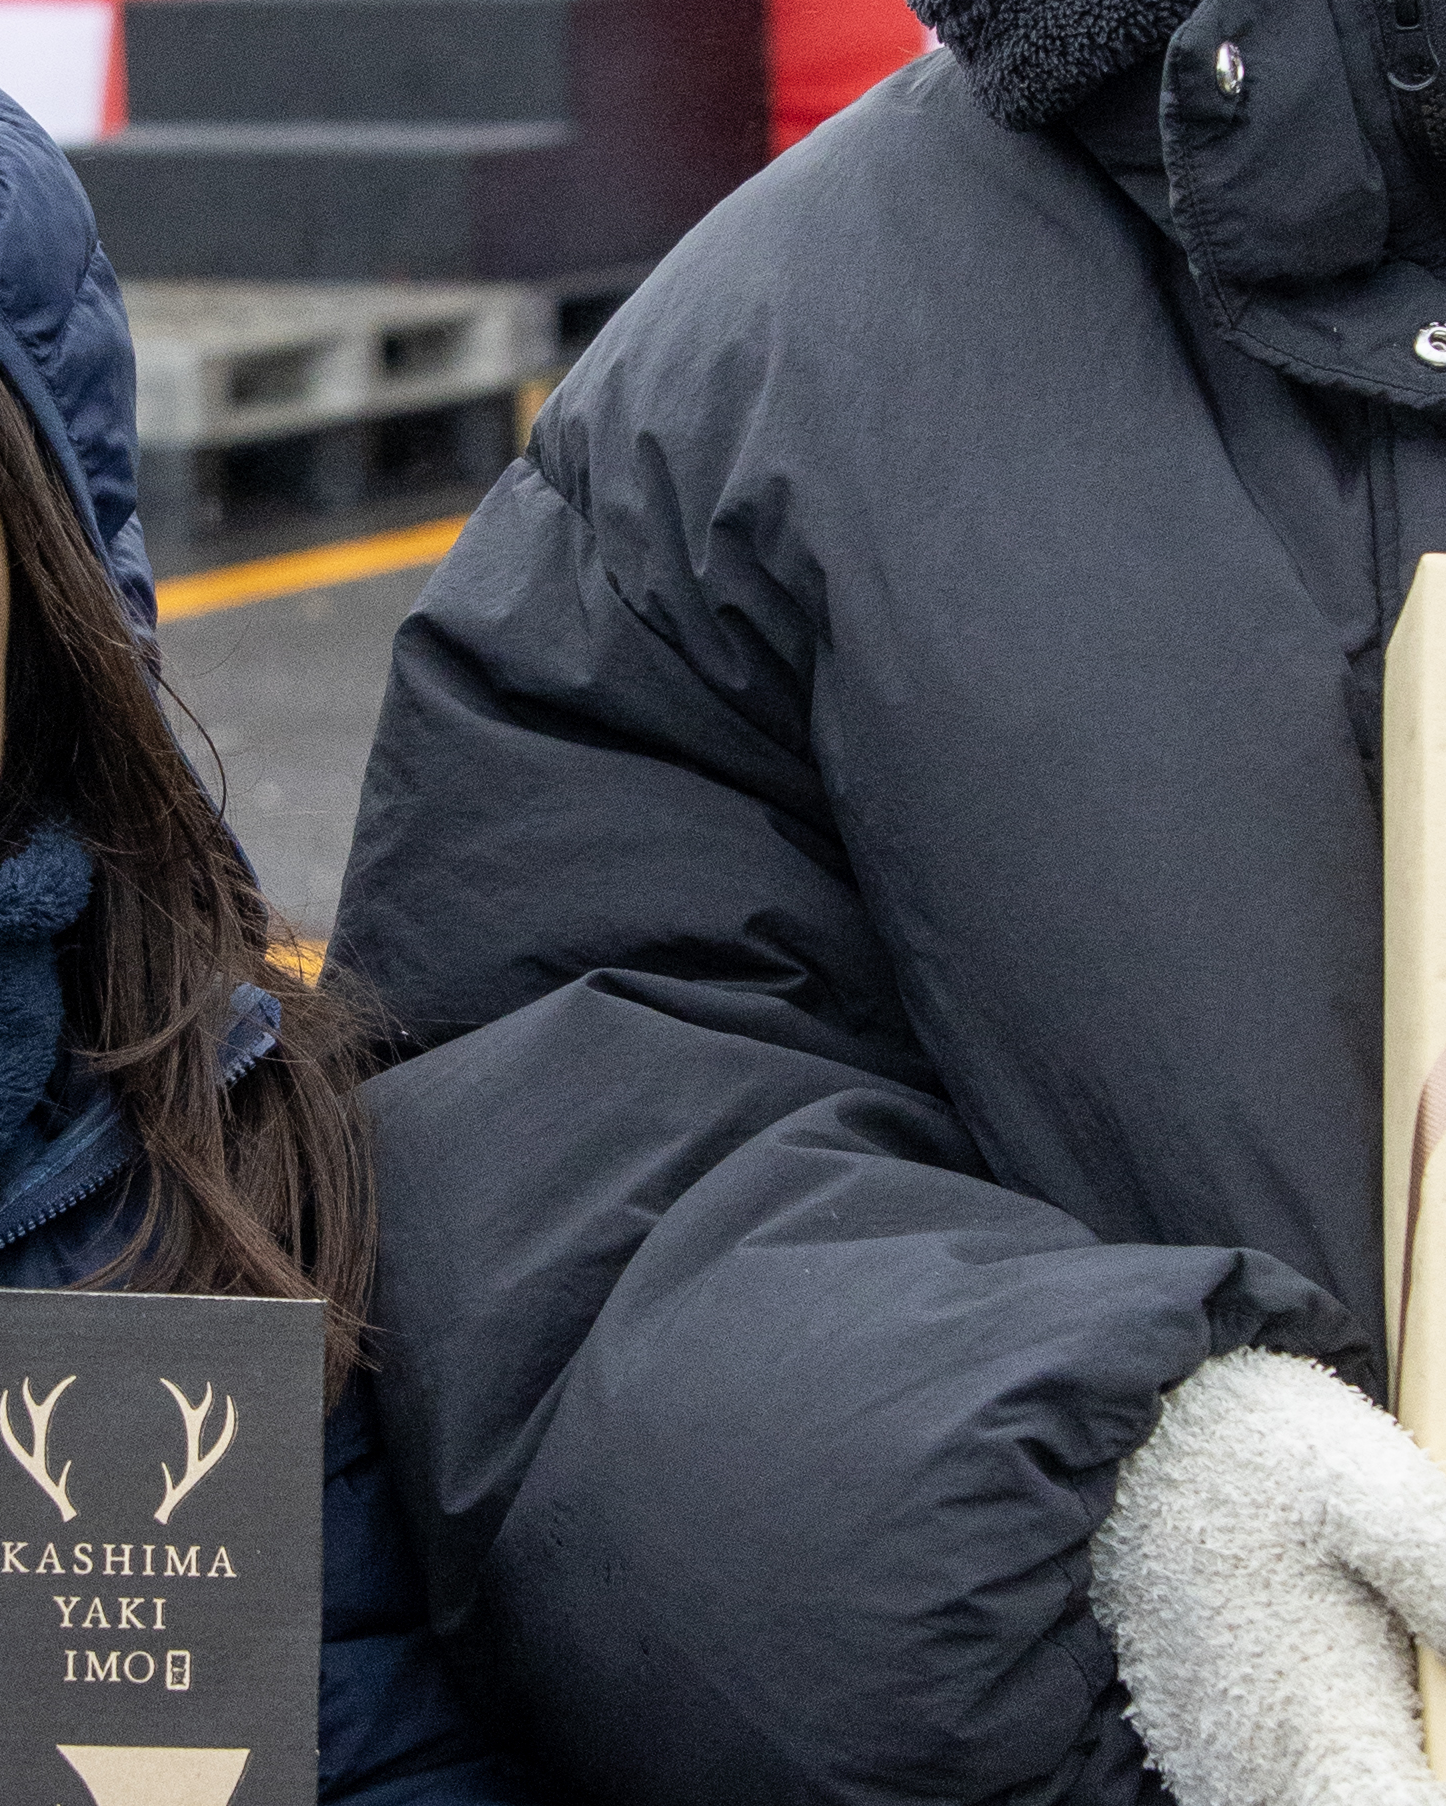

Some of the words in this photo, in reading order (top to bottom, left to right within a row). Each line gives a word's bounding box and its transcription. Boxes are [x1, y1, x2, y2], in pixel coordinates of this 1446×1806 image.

[1, 1541, 238, 1578] KASHIMA
[53, 1595, 167, 1630] YAKI
[63, 1649, 155, 1684] IMO
